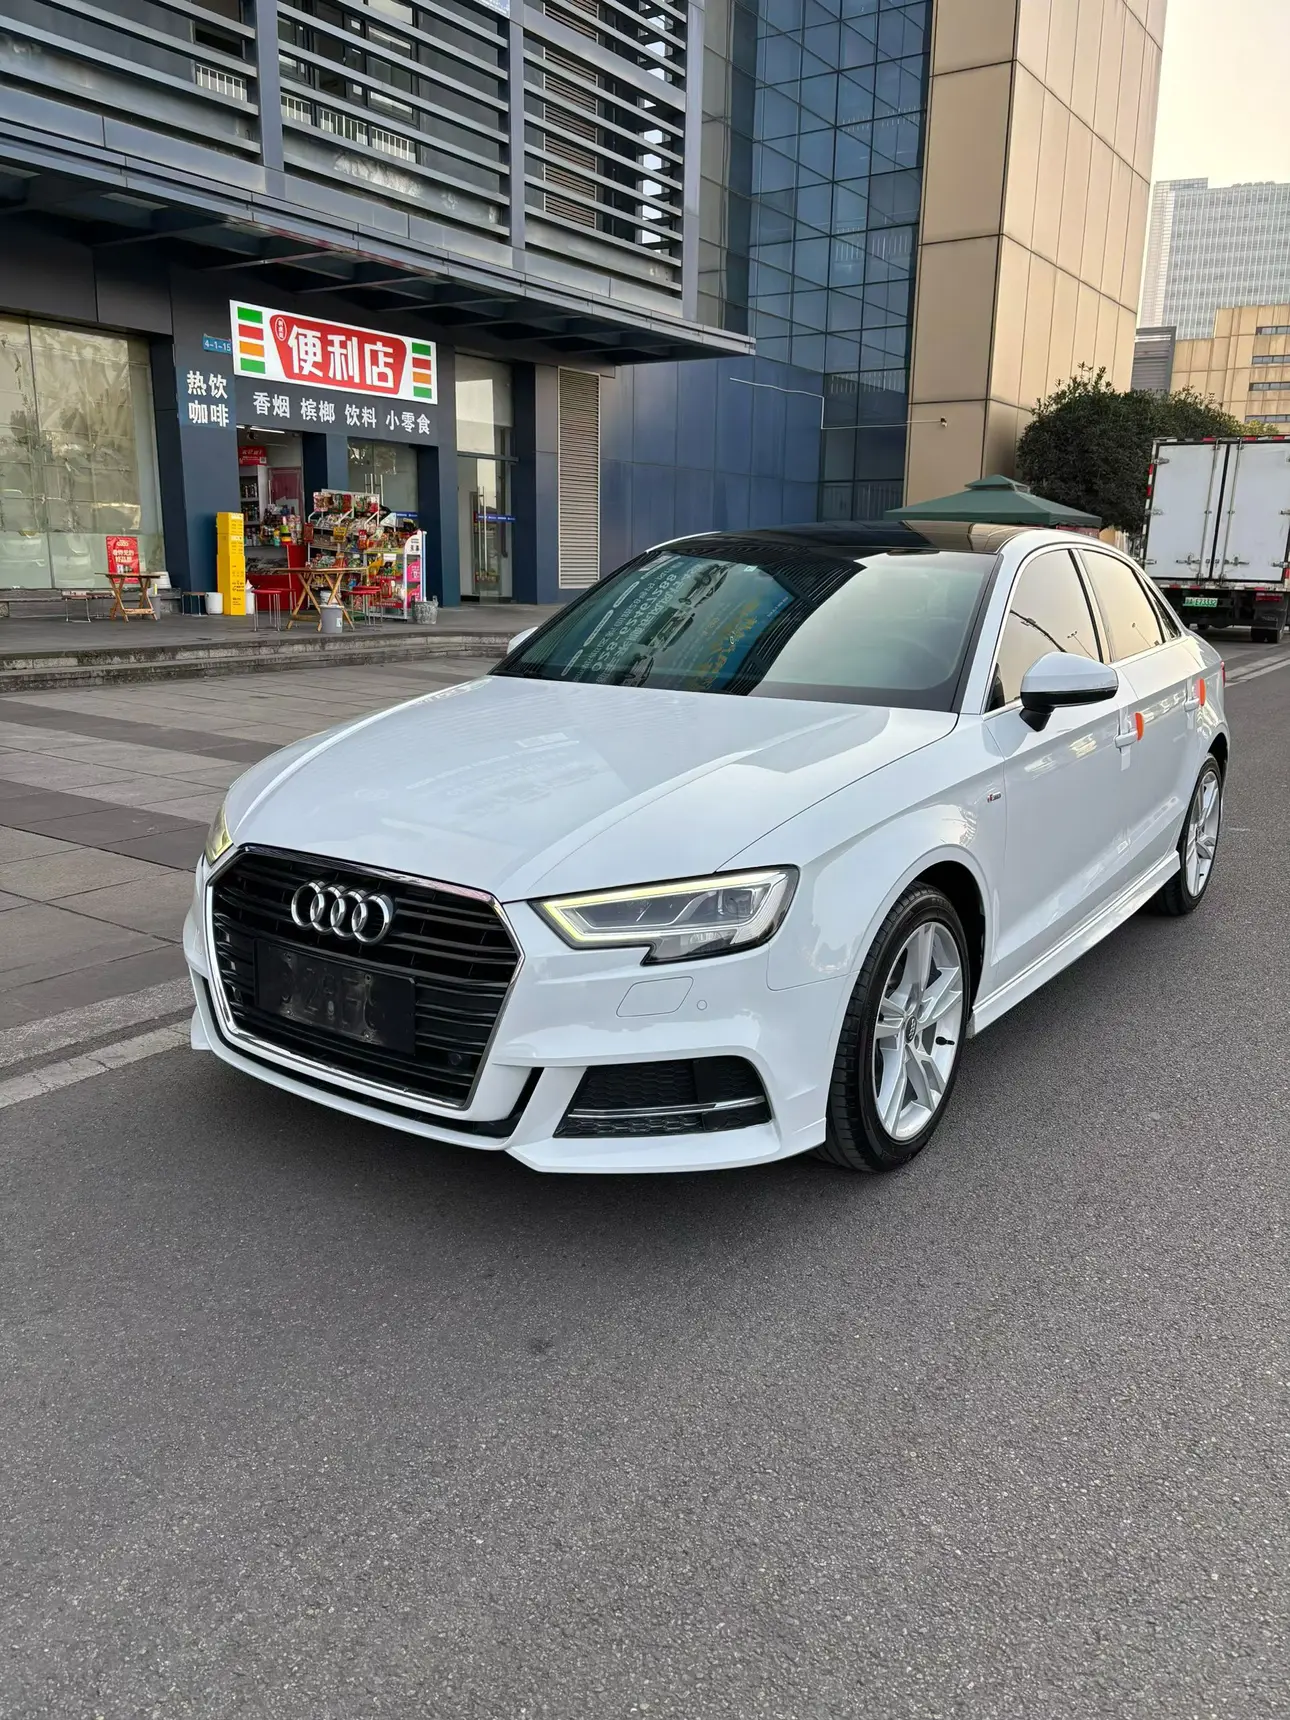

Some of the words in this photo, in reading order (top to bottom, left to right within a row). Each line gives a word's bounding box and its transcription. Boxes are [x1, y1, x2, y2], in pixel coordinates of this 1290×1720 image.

[288, 325, 394, 387] 便利店
[187, 370, 228, 399] 热饮
[188, 401, 230, 427] 咖啡
[253, 391, 290, 418] 香烟
[300, 397, 335, 423] 槟榔
[344, 404, 377, 428] 饮料
[386, 411, 430, 434] 小零食
